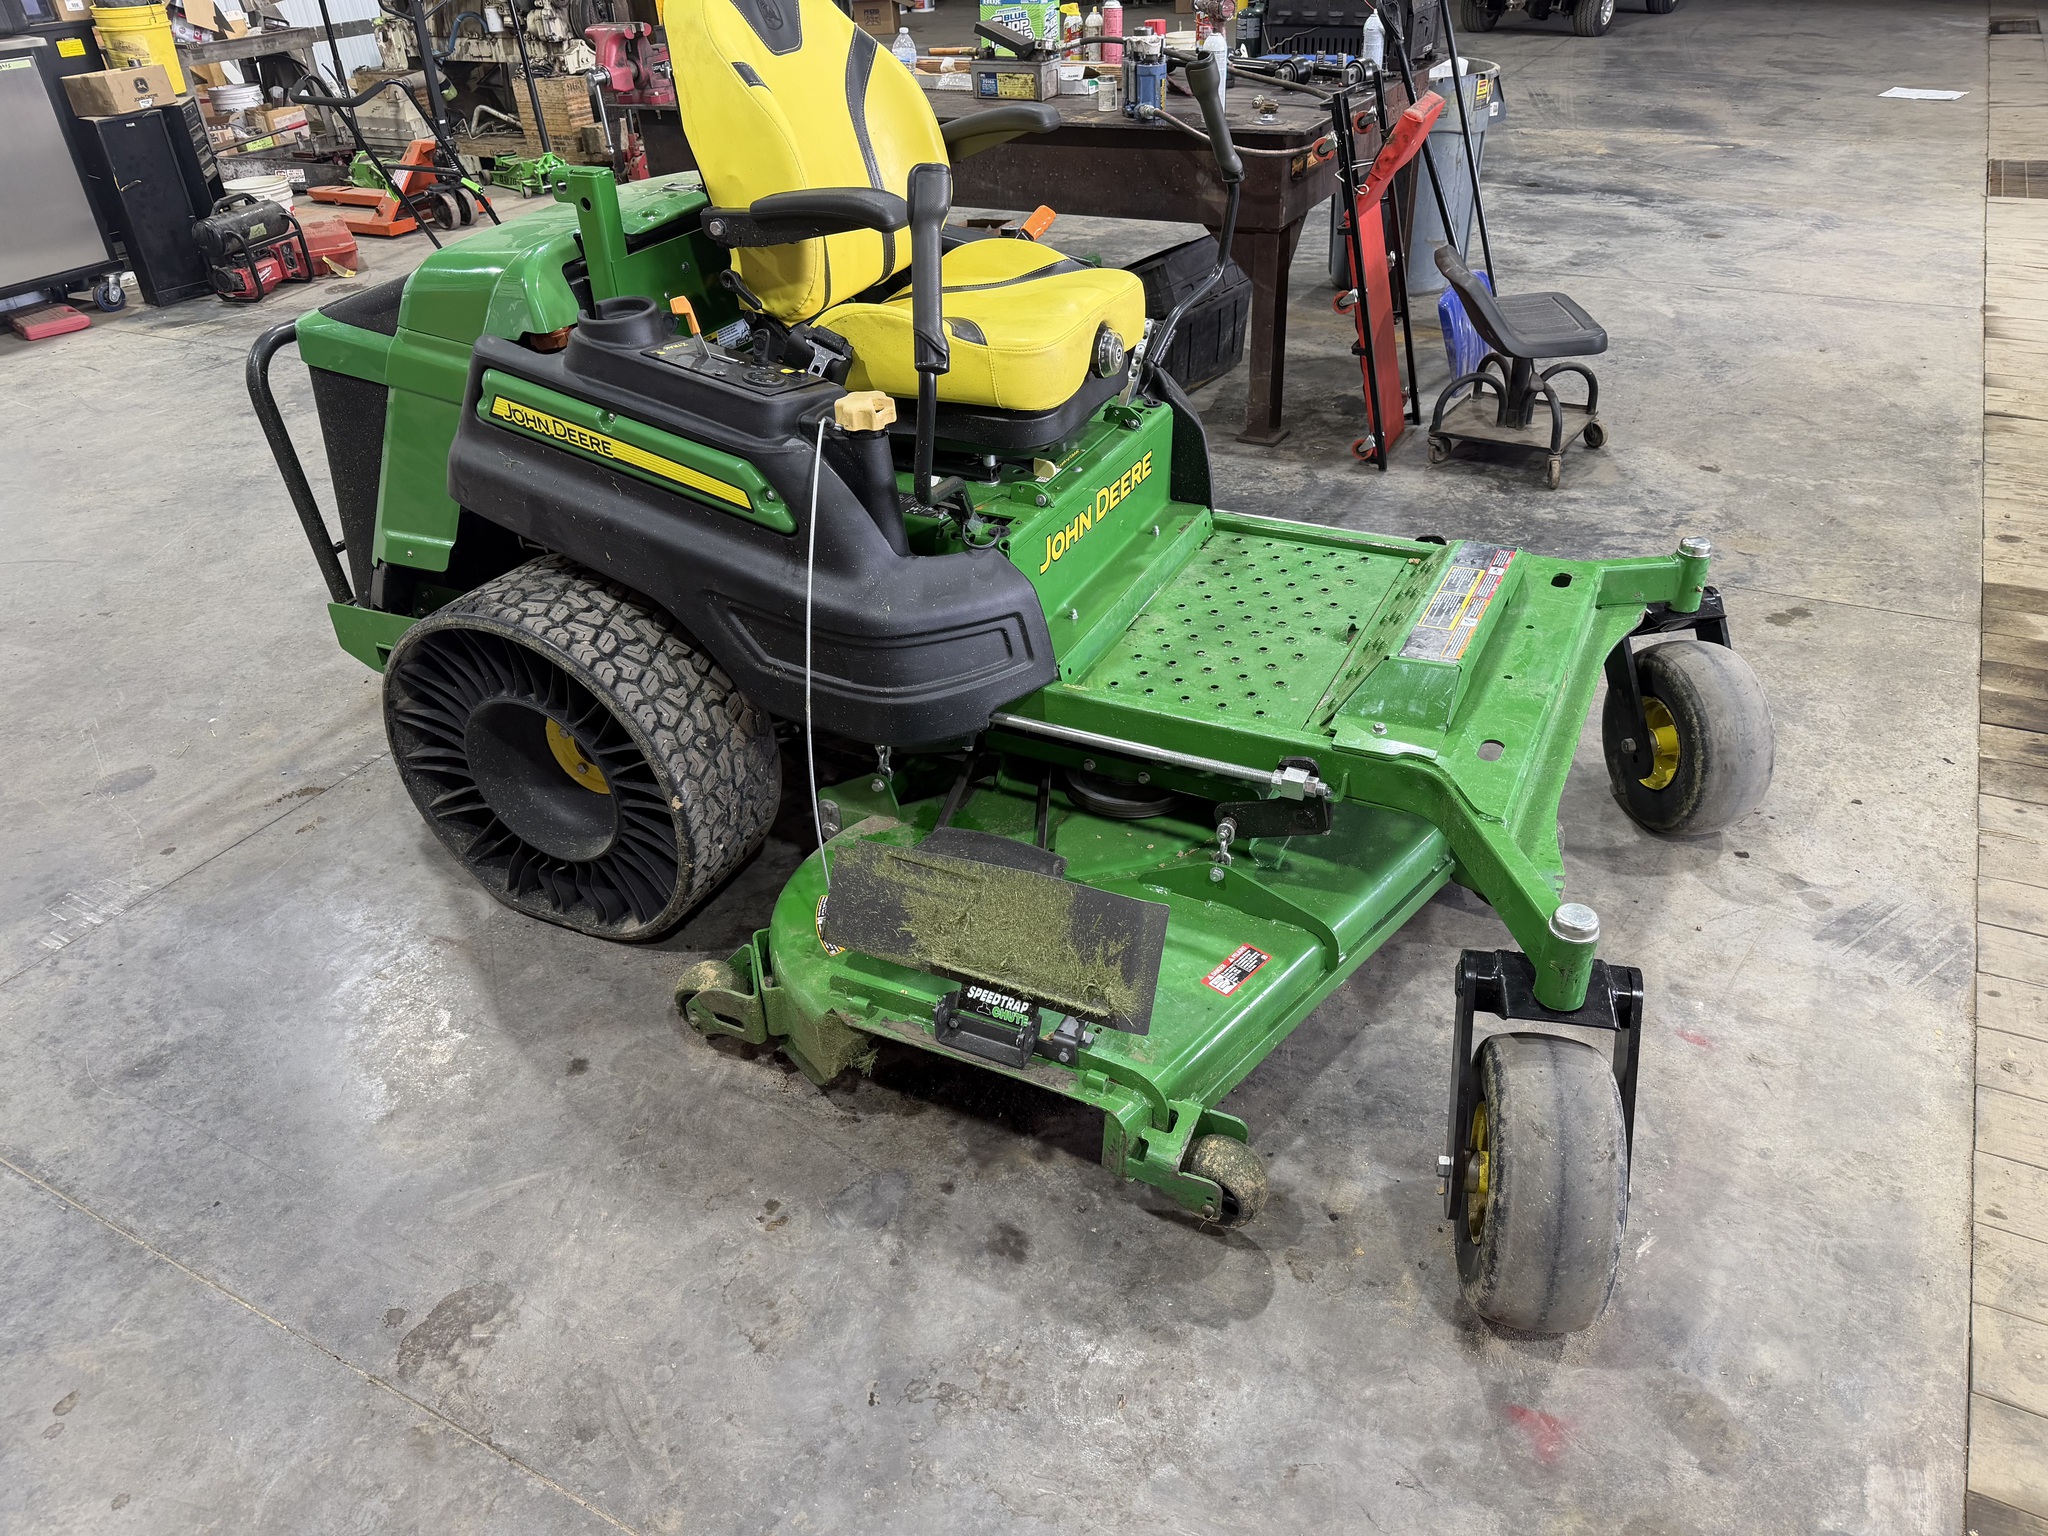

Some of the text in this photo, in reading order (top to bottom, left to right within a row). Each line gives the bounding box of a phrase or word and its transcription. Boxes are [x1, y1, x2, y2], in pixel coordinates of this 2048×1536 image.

[1004, 11, 1027, 21] BLUE
[503, 403, 613, 457] JOHN DEERE
[1039, 449, 1153, 576] JOHN DEERE
[967, 985, 1030, 1013] SPEEDTRAP
[991, 1005, 1029, 1027] CHUTE
